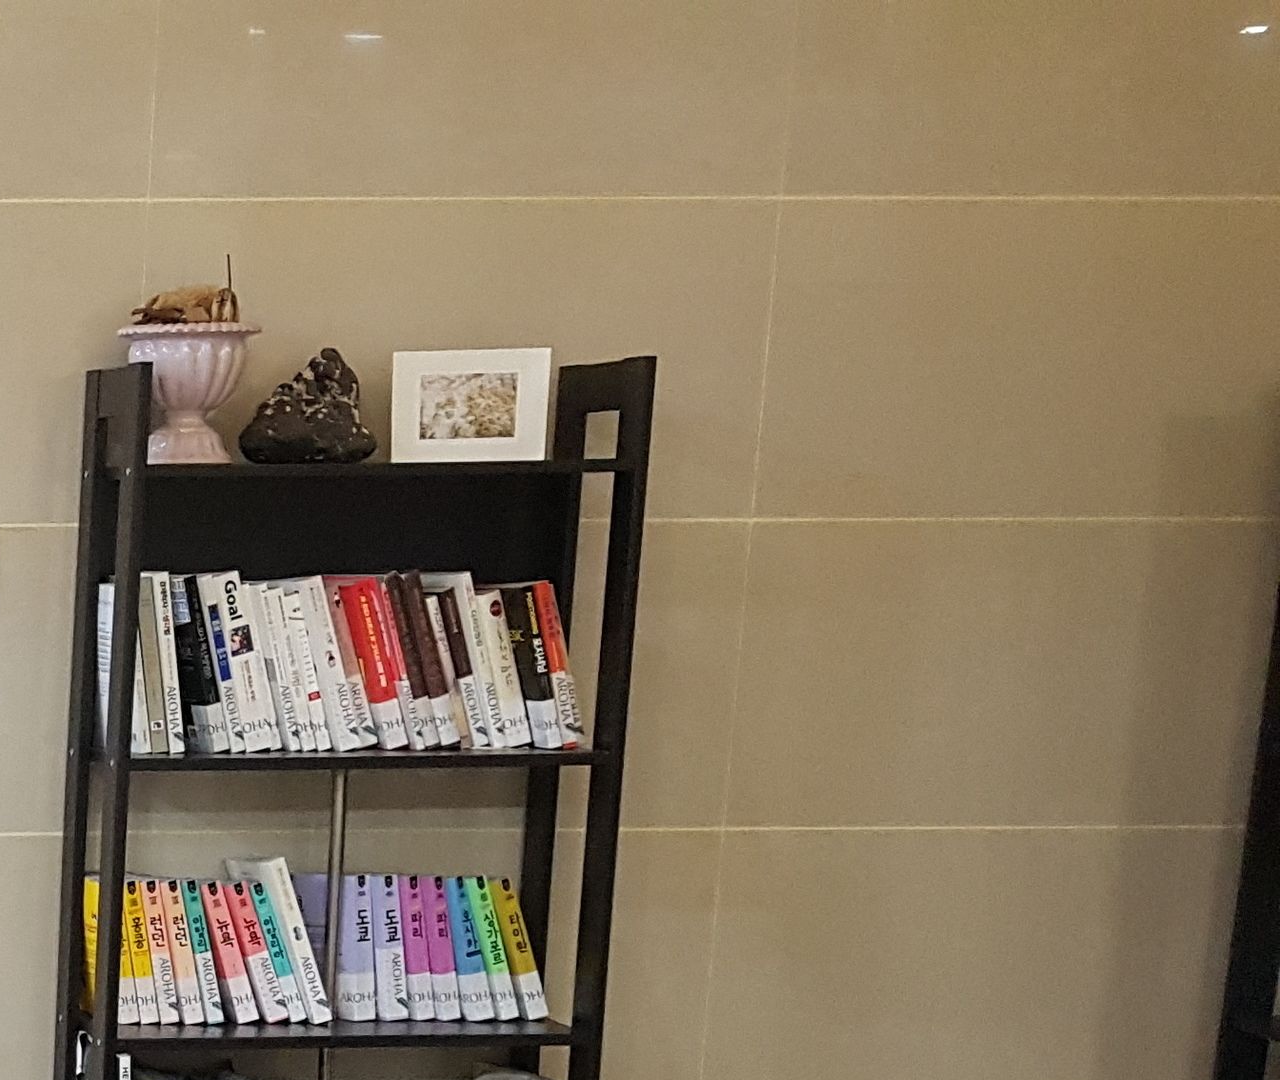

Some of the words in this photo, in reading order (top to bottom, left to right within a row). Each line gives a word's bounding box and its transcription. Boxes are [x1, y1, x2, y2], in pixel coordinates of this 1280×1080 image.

[224, 580, 243, 621] Goal
[533, 637, 548, 674] 포지셔닝
[166, 686, 179, 731] AROHA
[224, 685, 240, 730] AROHA
[337, 682, 355, 727] AROHA
[462, 681, 480, 726] AROHA
[133, 917, 144, 949] 홍콩
[150, 914, 165, 948] 런던
[173, 914, 187, 947] 런던
[217, 918, 234, 948] 뉴욕
[244, 917, 261, 948] 뉴욕
[356, 909, 371, 943] 도쿄
[384, 909, 400, 943] 도쿄
[411, 911, 423, 939] 파리
[436, 911, 449, 939] 파리
[159, 957, 175, 1005] AROHA
[201, 957, 218, 1005] AROHA
[260, 956, 283, 1004] AROHA
[301, 956, 321, 999] AROHA
[392, 952, 404, 1001] AROHA
